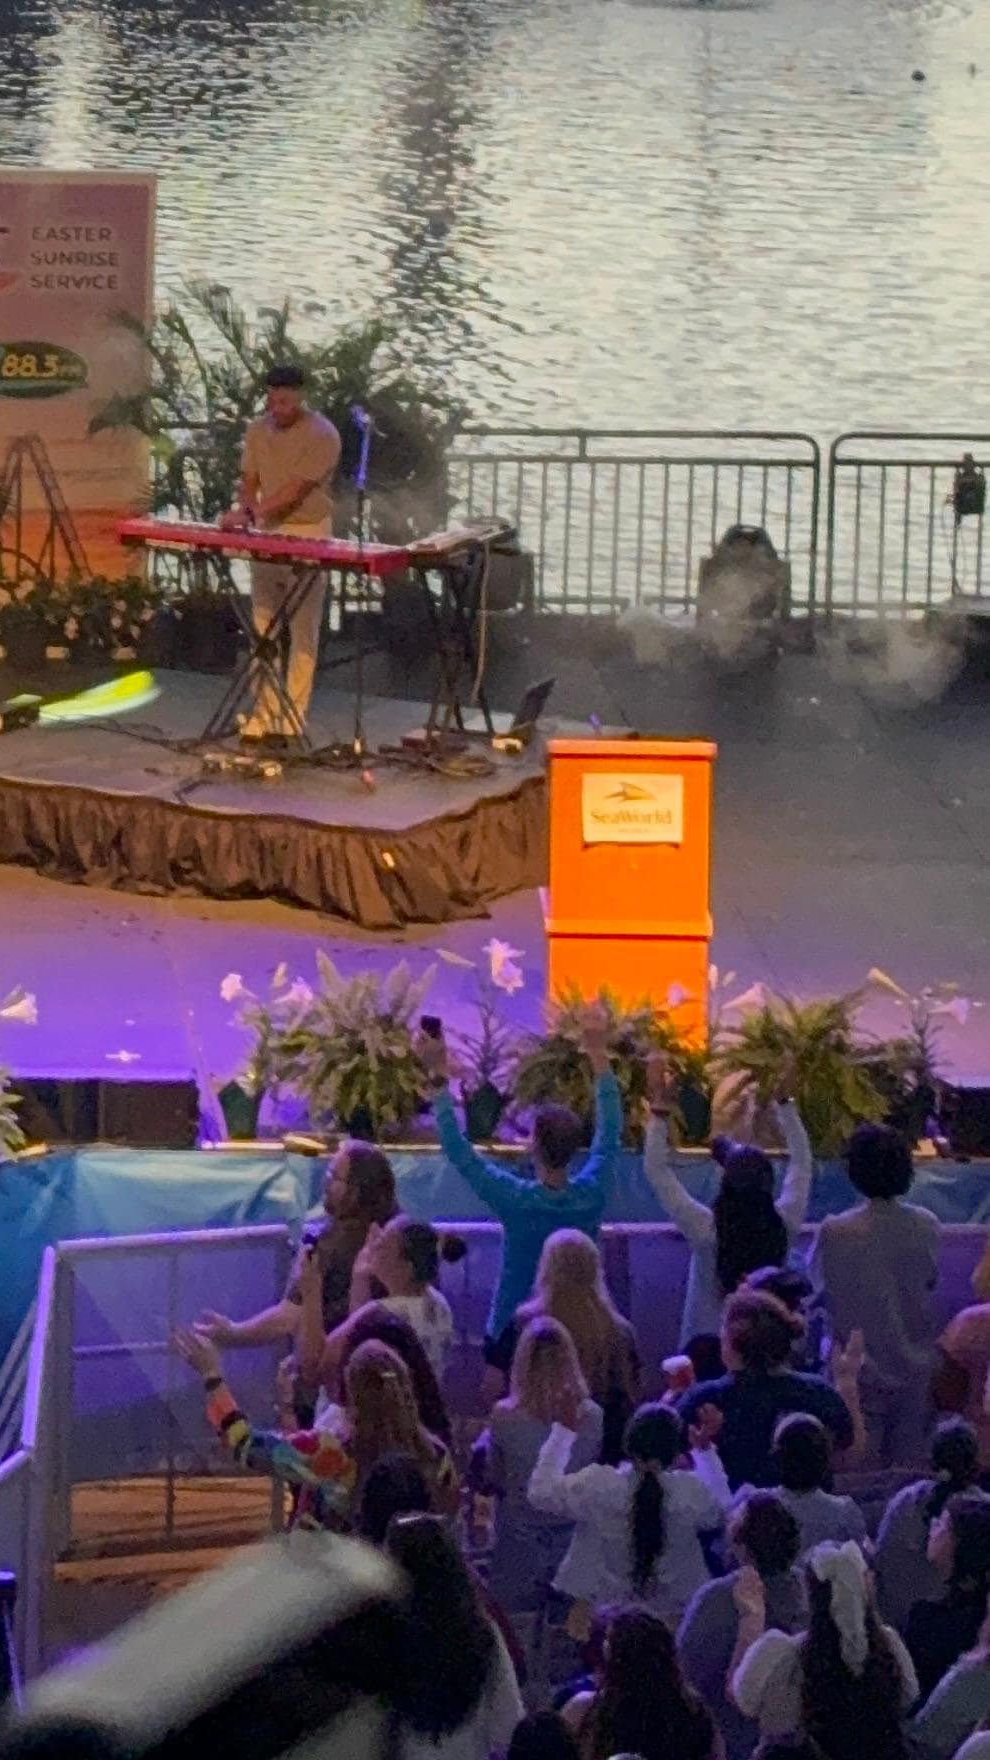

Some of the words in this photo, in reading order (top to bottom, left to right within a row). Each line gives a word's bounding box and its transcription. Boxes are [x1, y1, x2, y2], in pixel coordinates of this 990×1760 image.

[32, 226, 113, 242] EASTER
[30, 251, 119, 267] SUNRISE
[30, 274, 119, 290] SERVICE
[590, 808, 673, 825] SeaWorld
